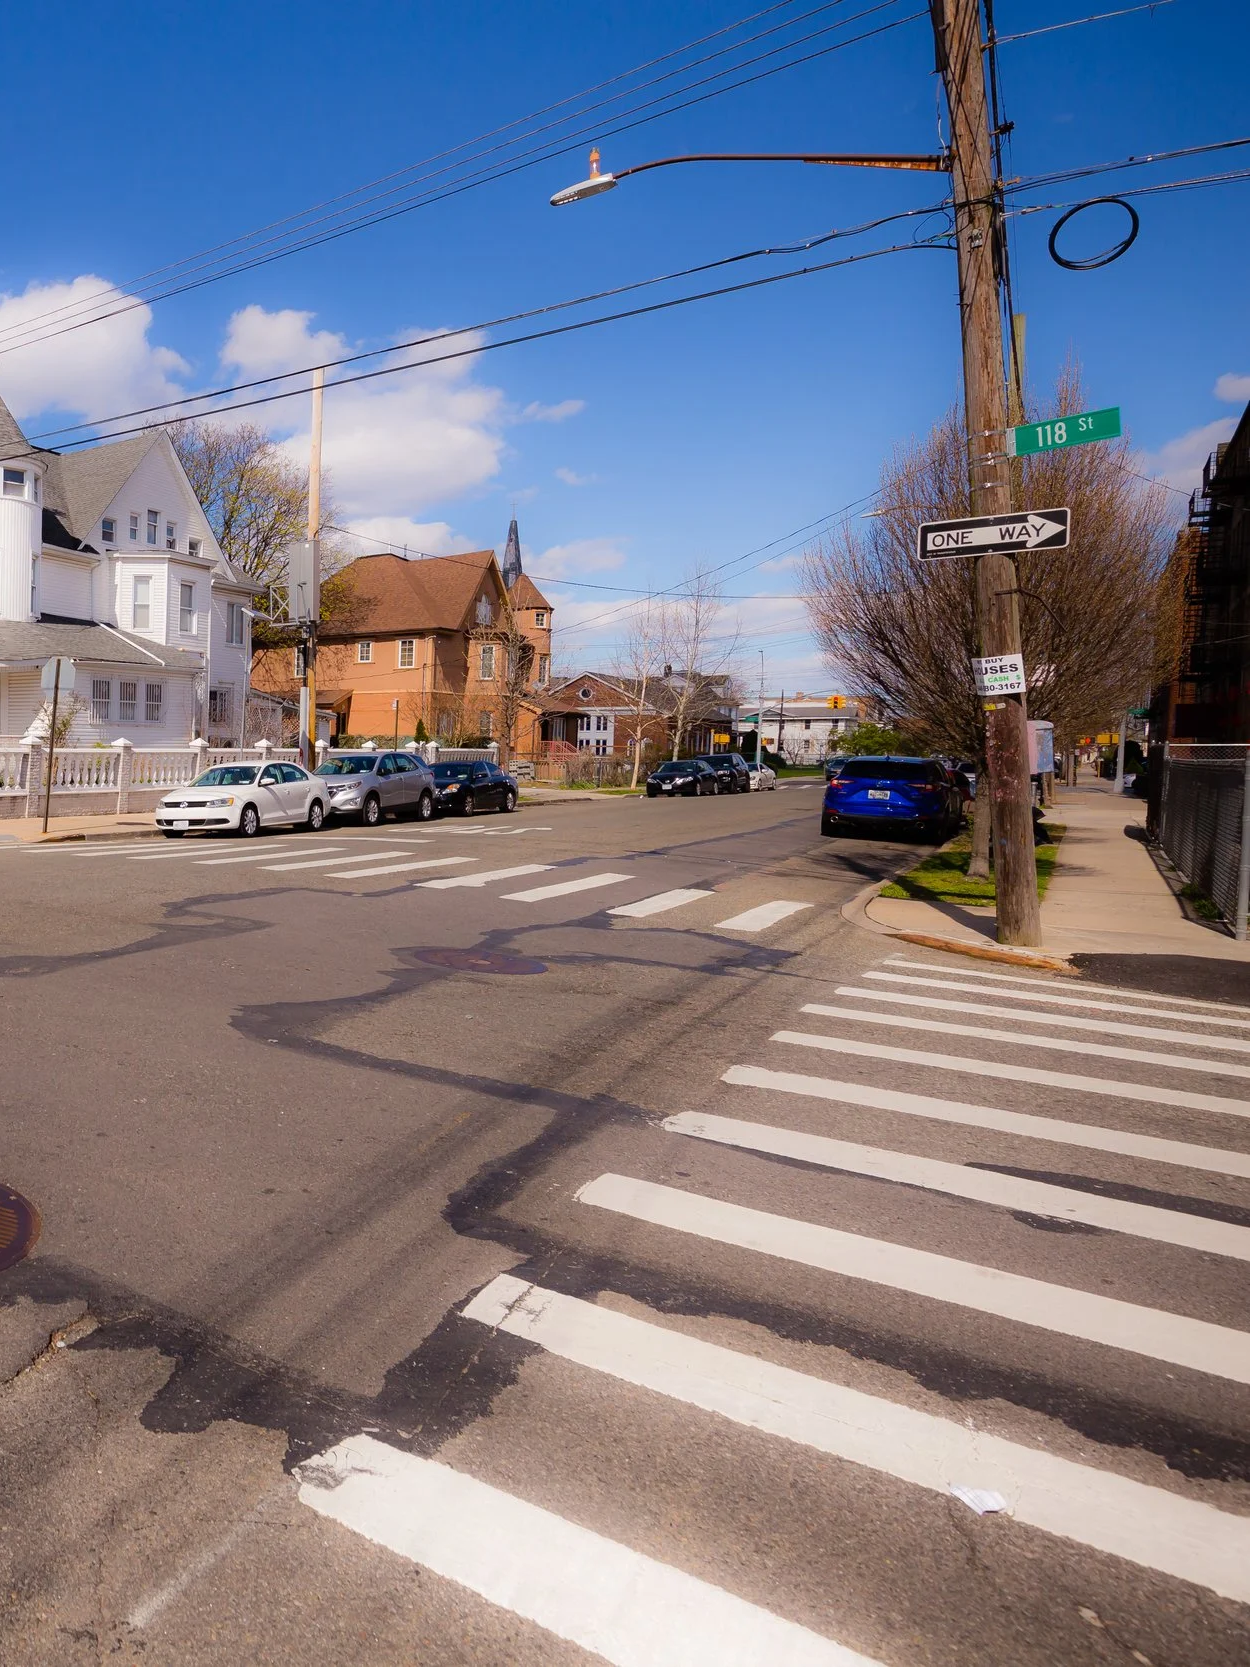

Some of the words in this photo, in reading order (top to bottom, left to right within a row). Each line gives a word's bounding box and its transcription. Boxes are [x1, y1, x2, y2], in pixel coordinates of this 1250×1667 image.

[1036, 421, 1067, 447] 118
[1078, 417, 1094, 431] St
[932, 530, 973, 548] ONE
[999, 522, 1046, 541] WAY
